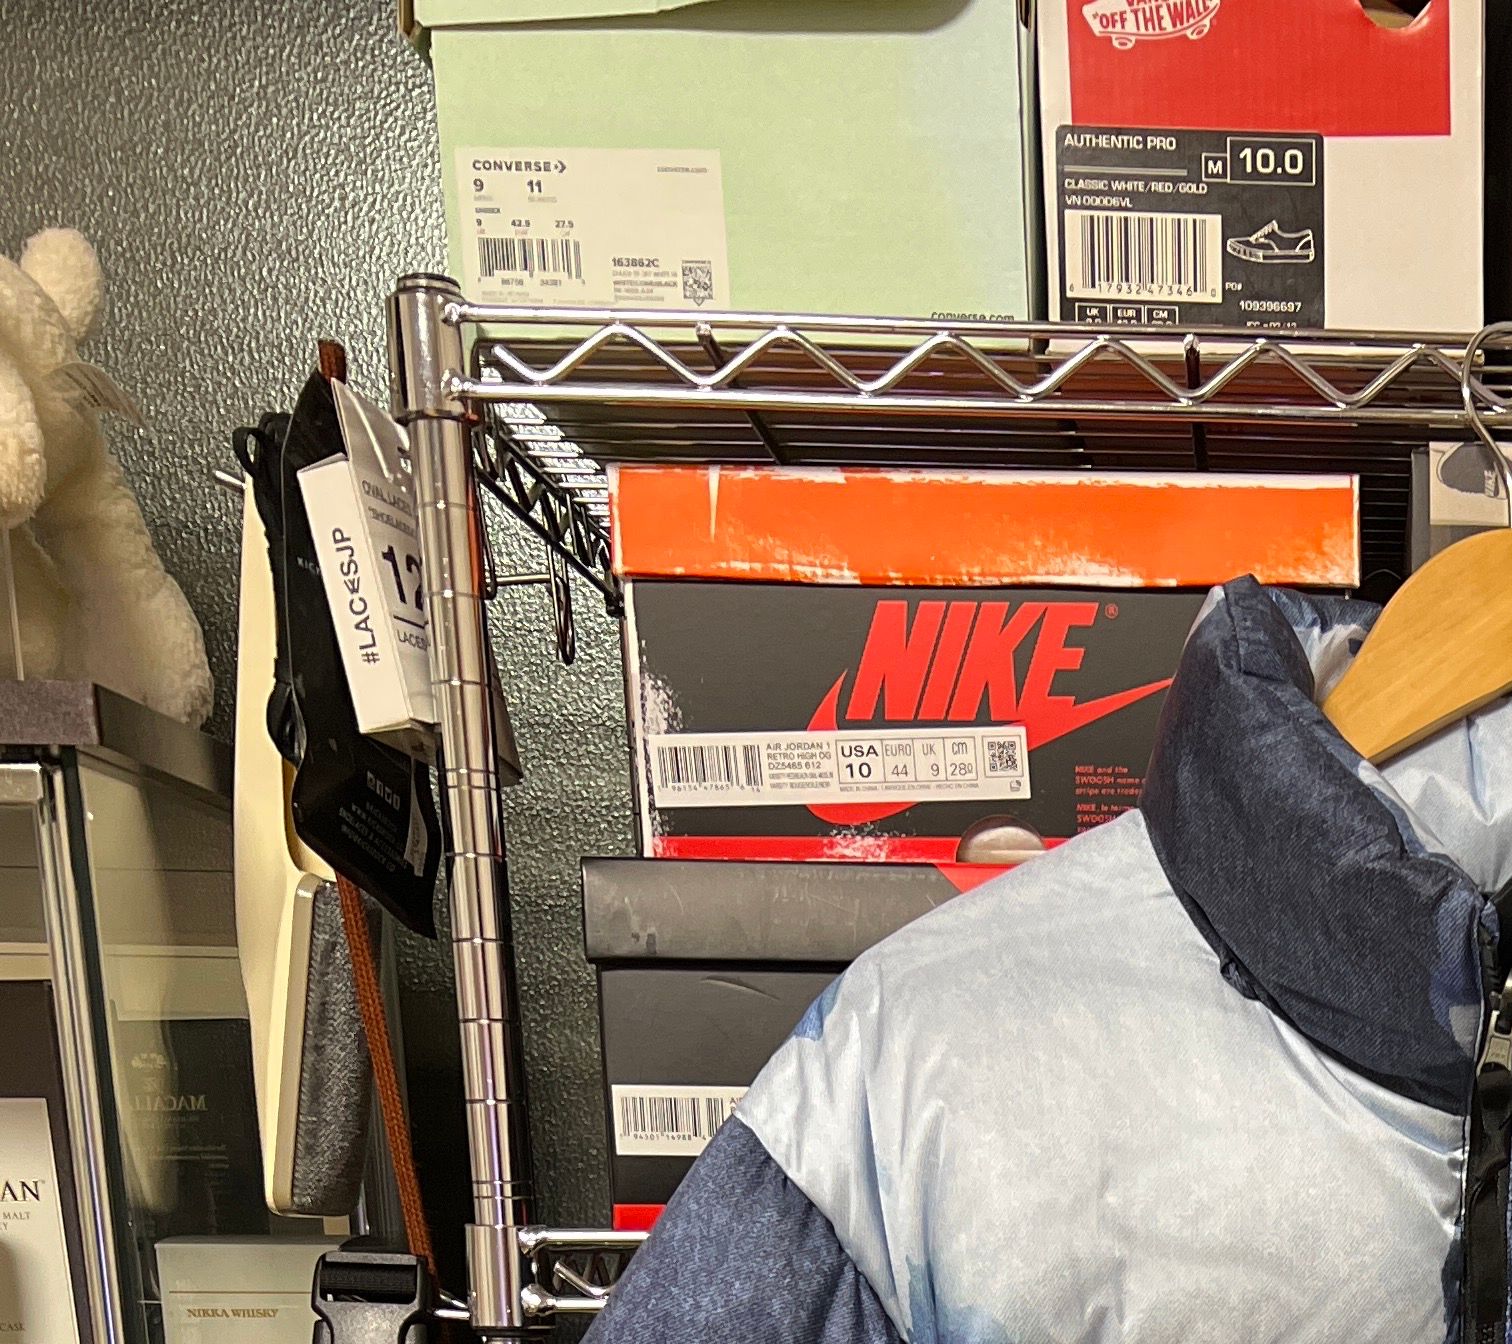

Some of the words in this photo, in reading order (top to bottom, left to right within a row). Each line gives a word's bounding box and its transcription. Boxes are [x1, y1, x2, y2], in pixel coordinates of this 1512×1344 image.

[1130, 4, 1167, 31] THE
[1064, 133, 1143, 151] AUTHENTIC
[1147, 136, 1177, 151] PRO
[472, 159, 551, 173] CONVERSE
[1208, 160, 1223, 176] M
[1239, 147, 1304, 175] 10.0
[472, 177, 484, 193] 9
[527, 179, 542, 194] 11
[1064, 179, 1109, 192] CLASSIC
[845, 600, 1099, 721] NIKE
[766, 741, 784, 752] AIR
[785, 741, 825, 752] JORDAN
[841, 744, 879, 760] USA
[885, 743, 912, 758] EURO
[922, 743, 936, 757] UK
[766, 752, 795, 761] RETRO
[846, 761, 873, 780] 10
[890, 764, 909, 779] 44
[930, 763, 940, 778] 9
